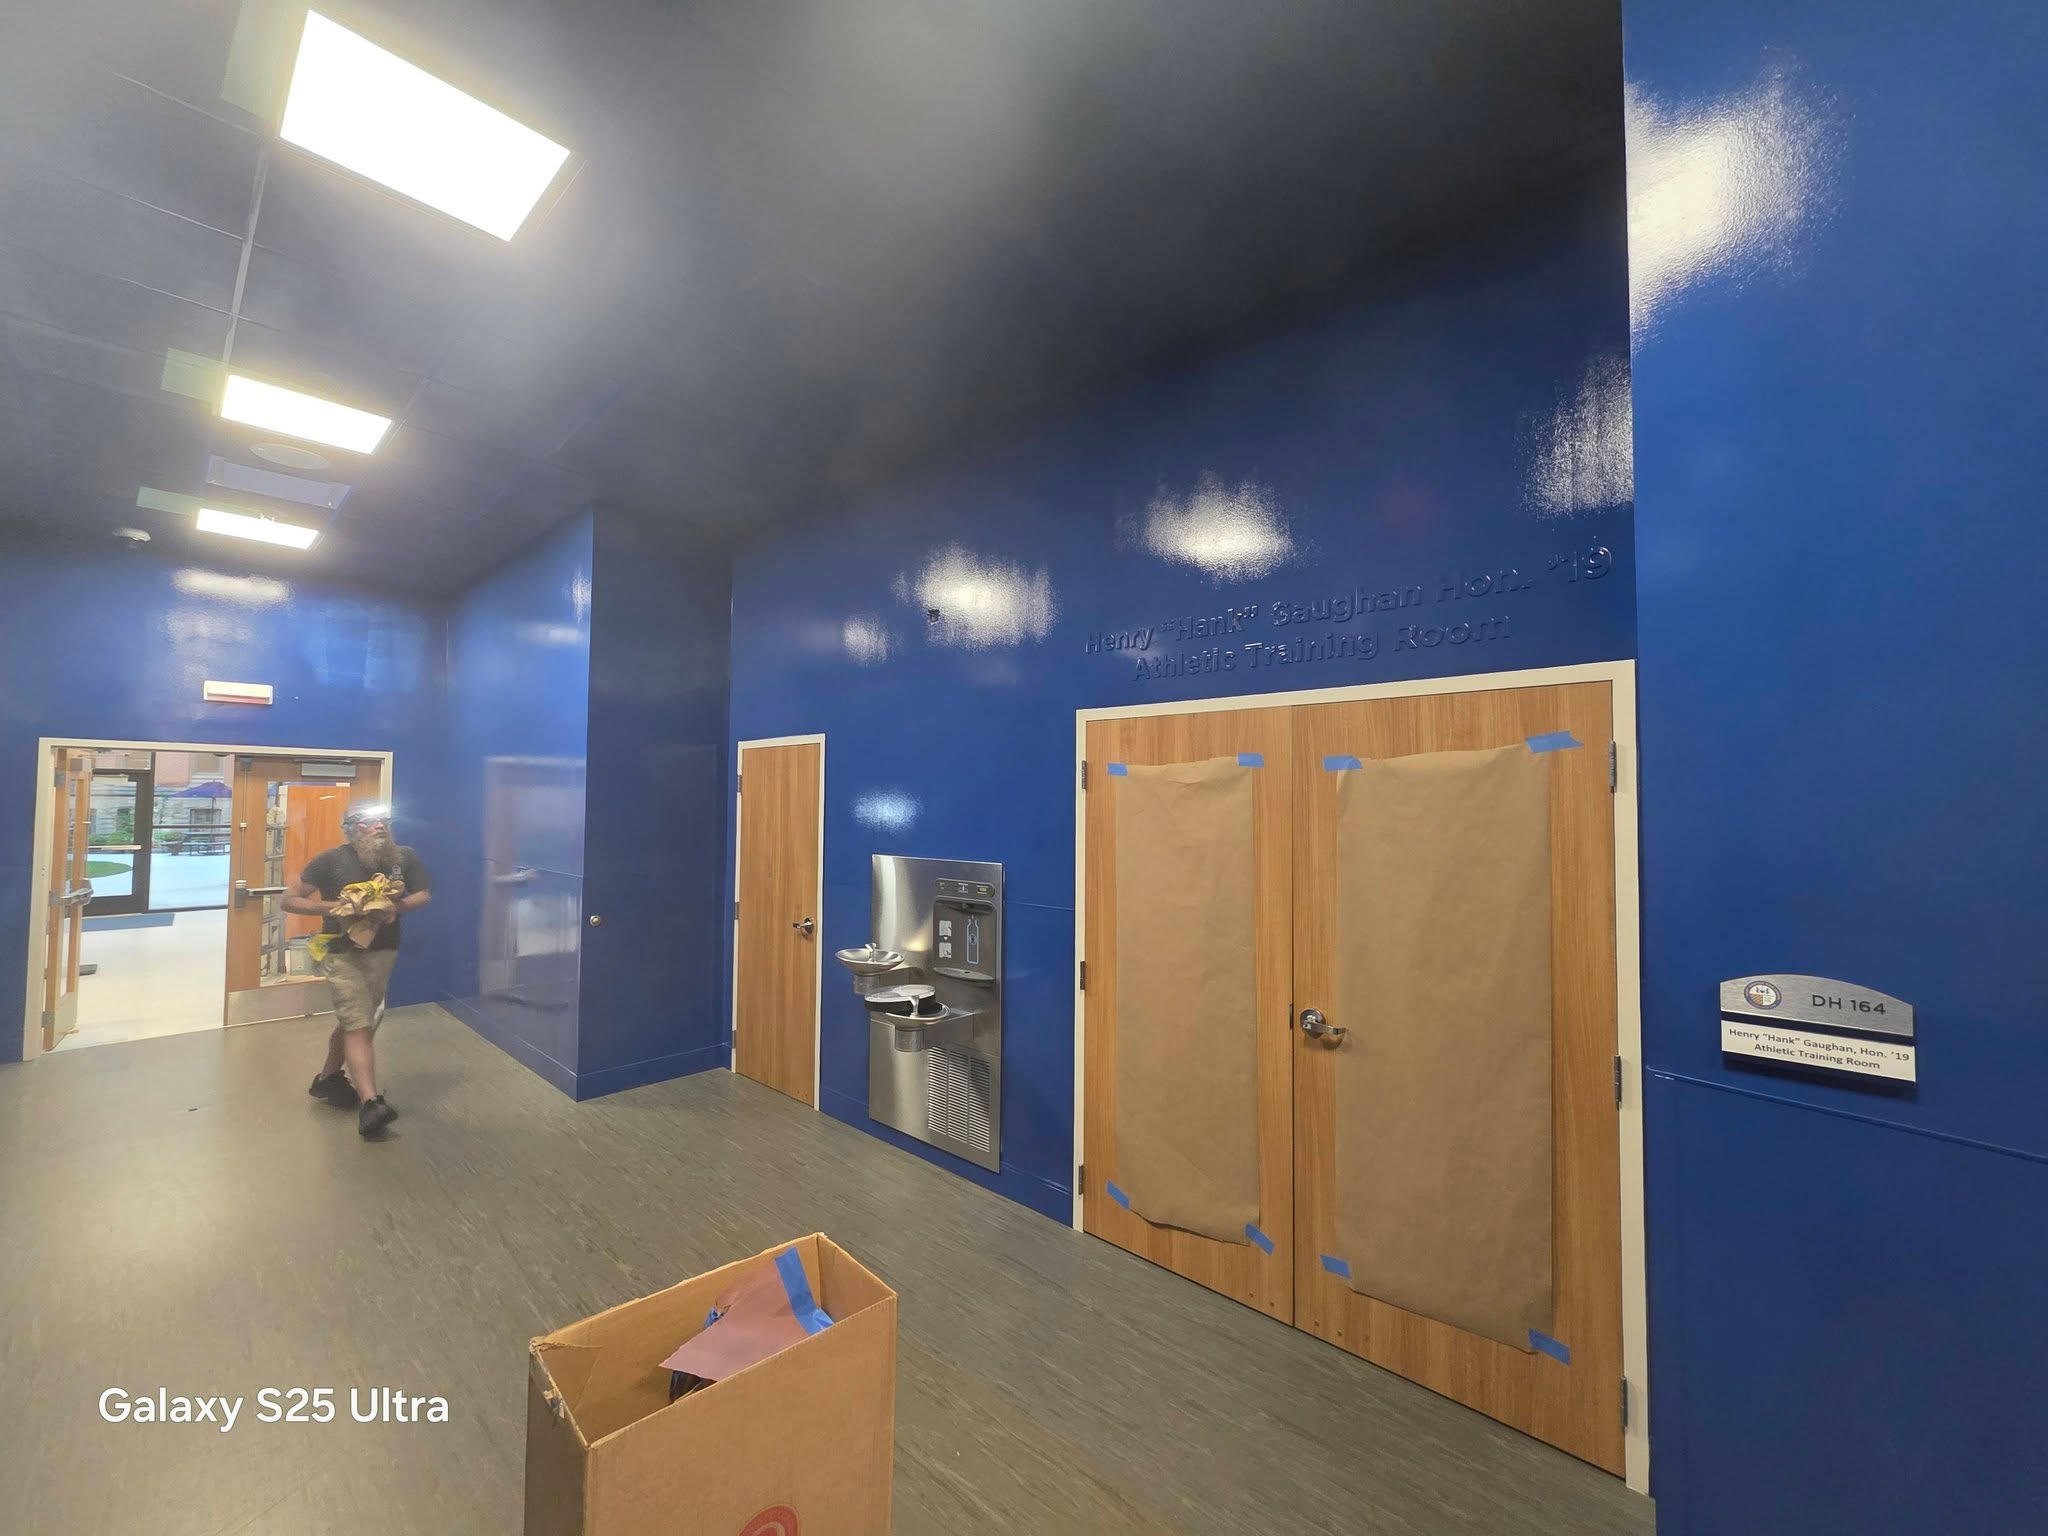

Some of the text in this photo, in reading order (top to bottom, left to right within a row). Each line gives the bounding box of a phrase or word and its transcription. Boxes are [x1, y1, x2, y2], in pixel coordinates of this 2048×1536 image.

[1085, 626, 1155, 654] Henry
[1271, 583, 1423, 627] Gaughan
[1134, 615, 1514, 681] Athletic Training Room
[1812, 994, 1887, 1015] DH 164
[1729, 1028, 1760, 1041] Henry
[1803, 1039, 1857, 1056] Gaughan,
[1860, 1047, 1888, 1059] Hon.
[1754, 1043, 1881, 1070] Athletic Training Room
